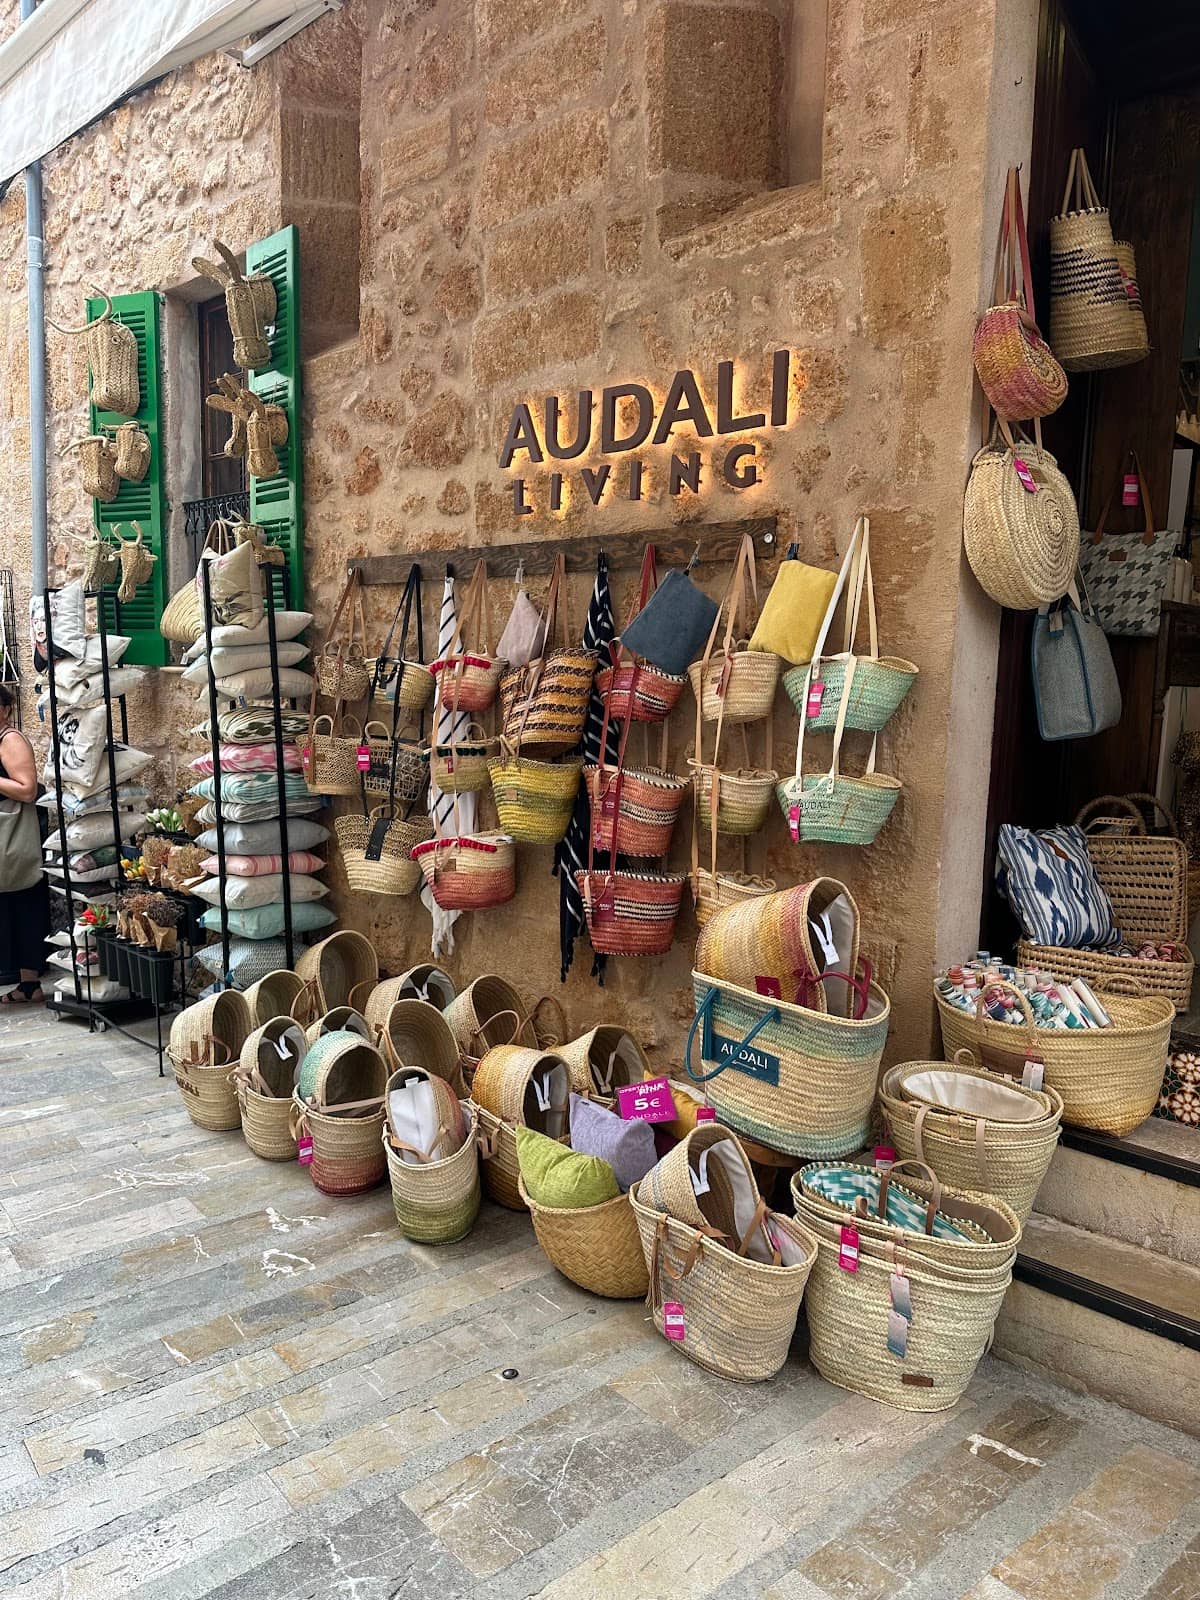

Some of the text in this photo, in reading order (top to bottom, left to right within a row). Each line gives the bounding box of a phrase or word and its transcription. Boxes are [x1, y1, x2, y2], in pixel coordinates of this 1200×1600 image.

[498, 349, 790, 469] AUDALI
[513, 443, 757, 515] LIVING
[634, 1097, 662, 1111] 5€
